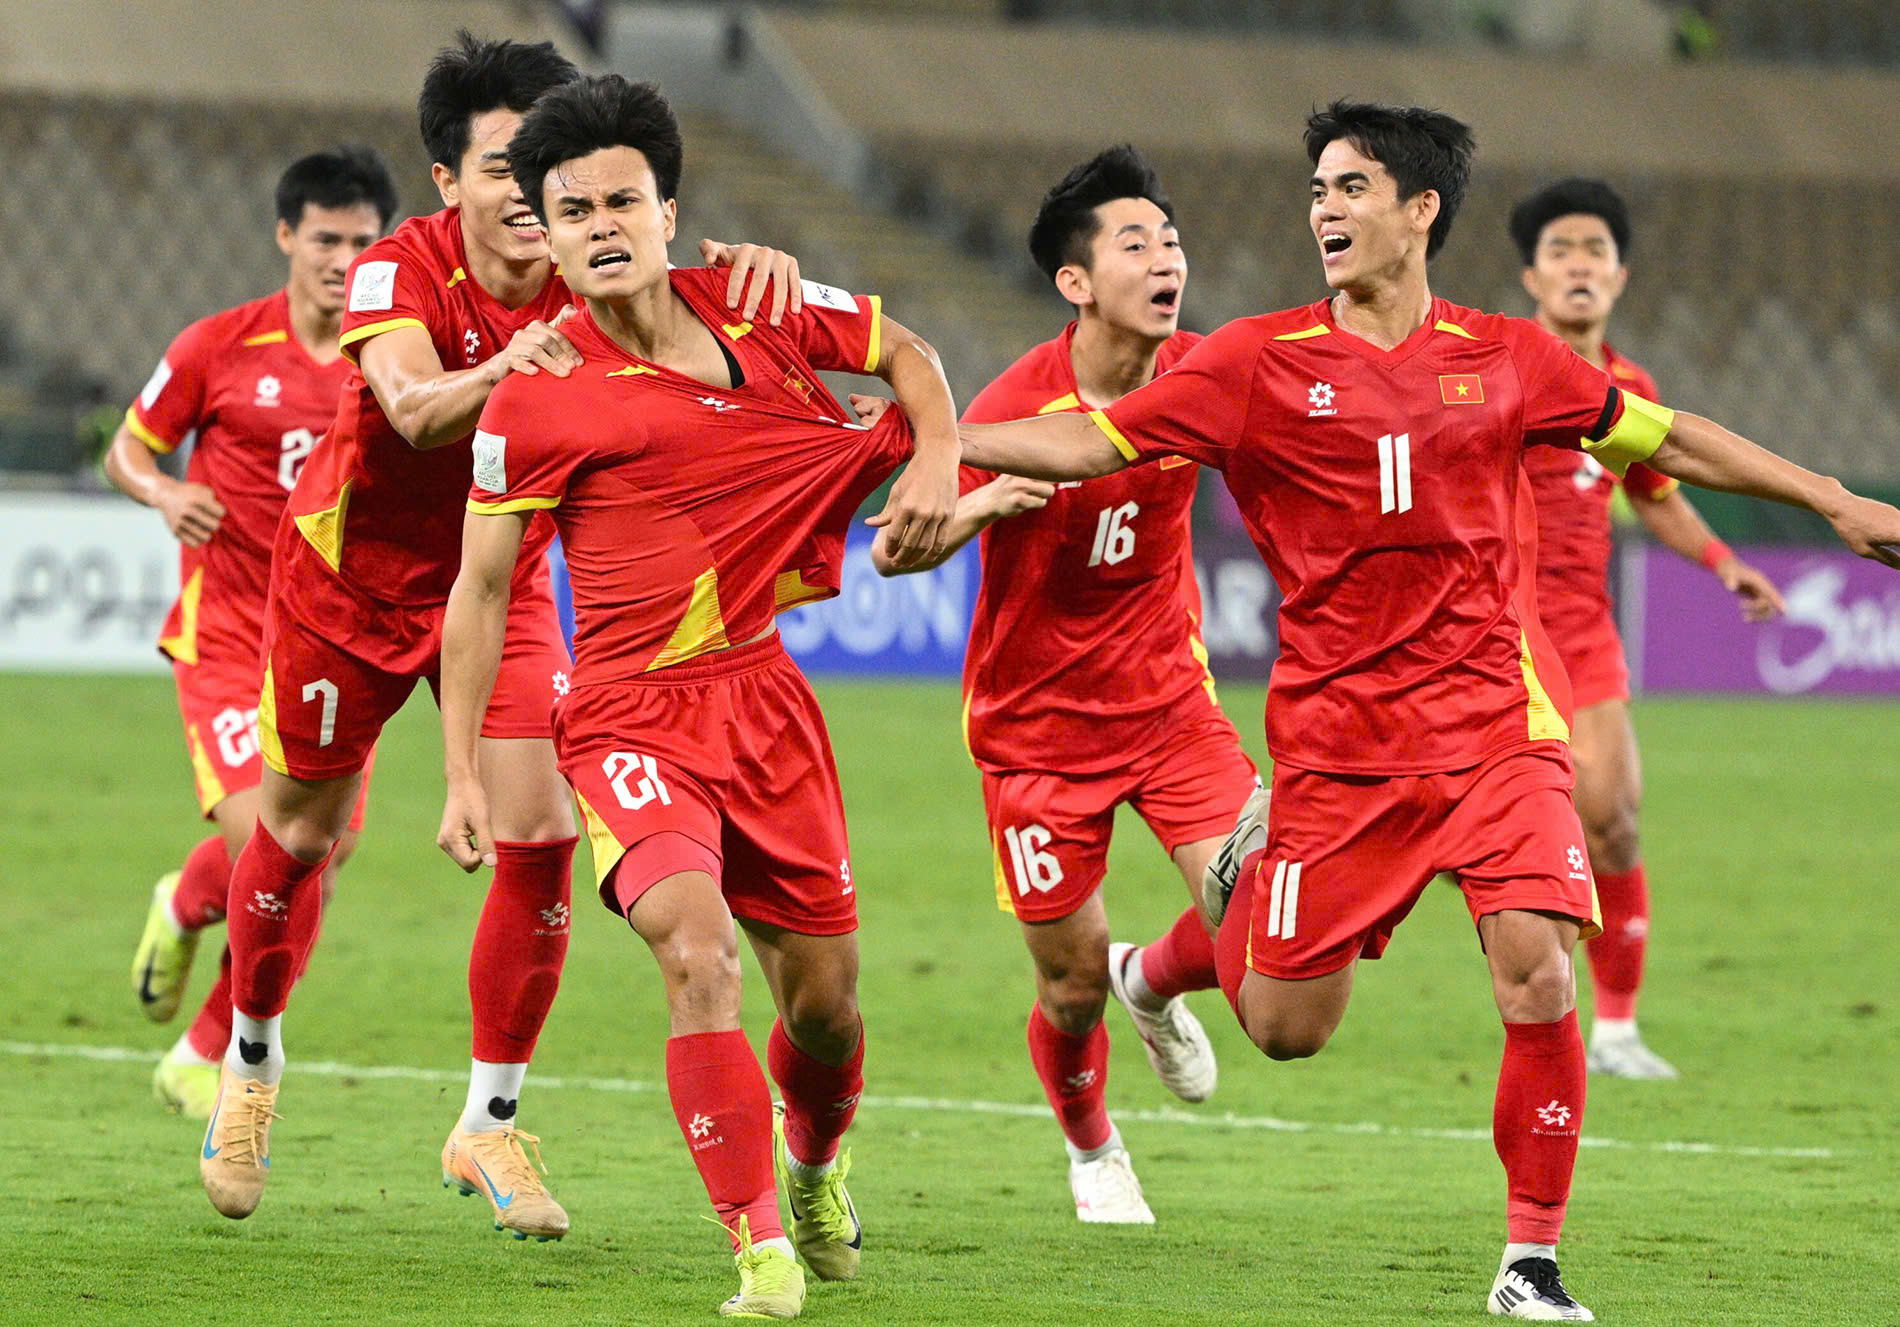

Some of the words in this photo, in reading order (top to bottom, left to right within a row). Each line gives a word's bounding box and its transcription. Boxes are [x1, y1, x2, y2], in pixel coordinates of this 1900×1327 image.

[277, 427, 325, 492] 2
[1378, 433, 1413, 515] 11
[1089, 501, 1139, 566] 16
[211, 705, 261, 769] 2
[302, 678, 339, 746] 7
[602, 752, 673, 811] 21
[1004, 825, 1064, 897] 16
[1267, 860, 1303, 940] 11
